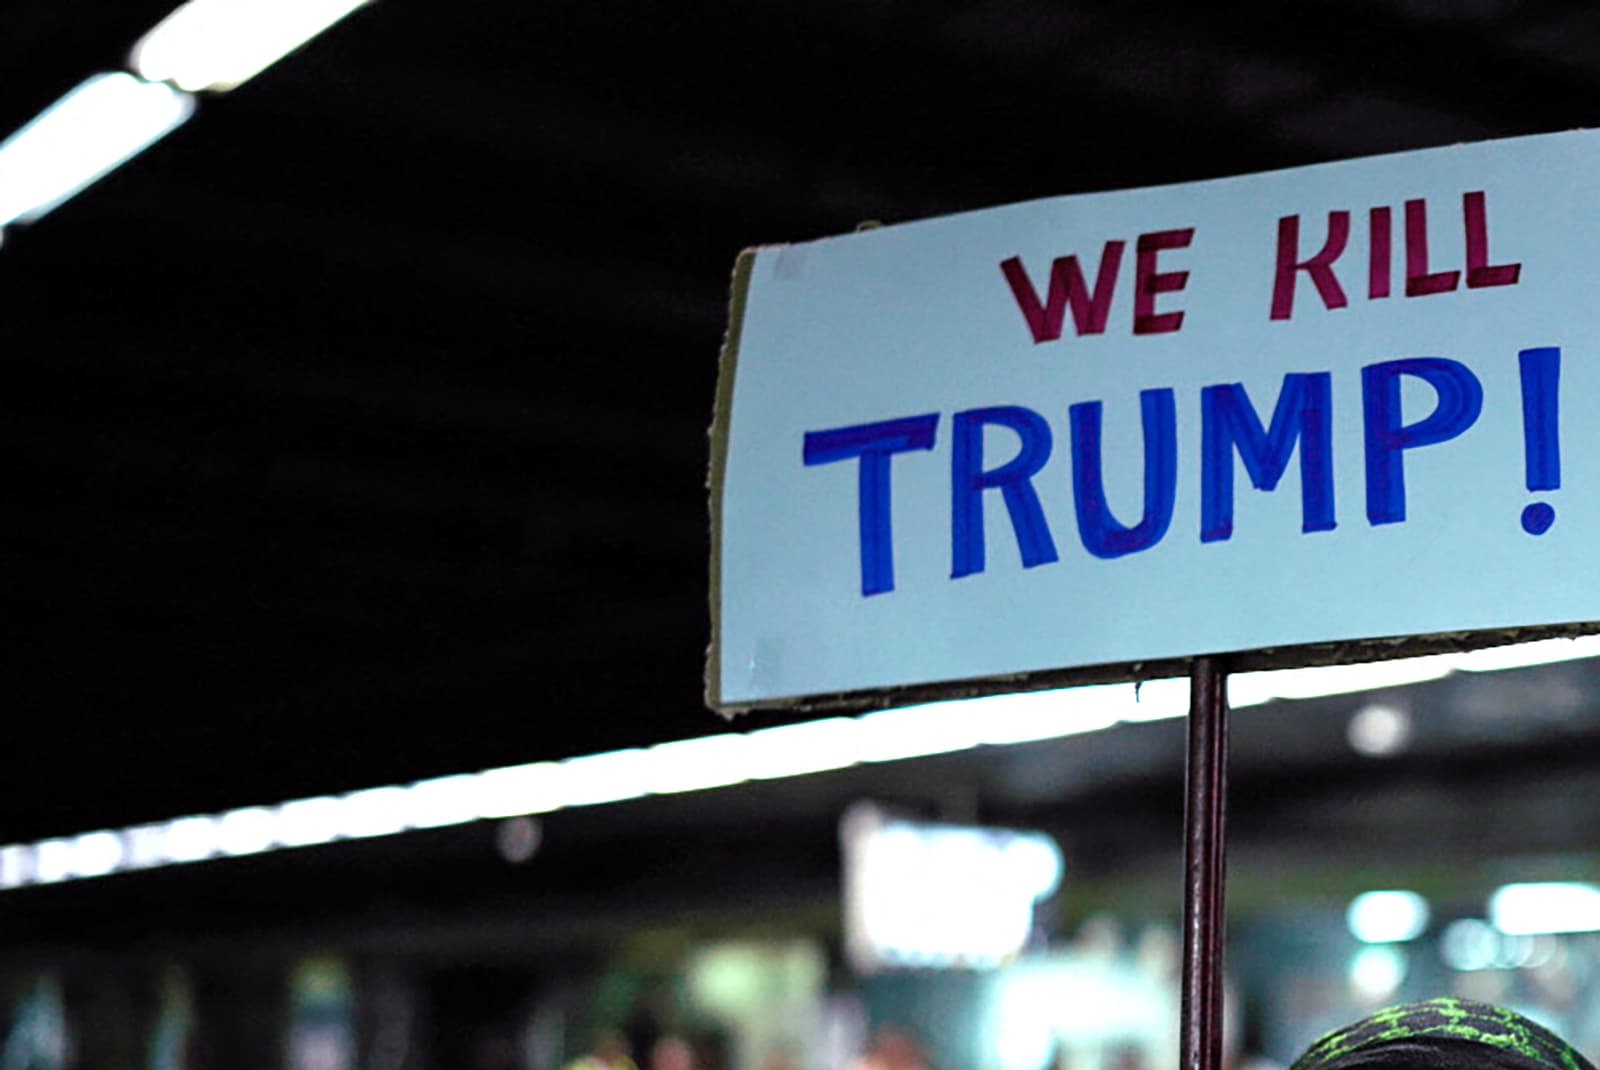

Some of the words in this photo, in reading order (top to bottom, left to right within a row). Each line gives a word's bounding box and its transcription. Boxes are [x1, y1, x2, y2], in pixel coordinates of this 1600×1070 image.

[1001, 228, 1194, 344] WE
[1269, 190, 1521, 321] KILL
[802, 346, 1561, 597] TRUMP!
